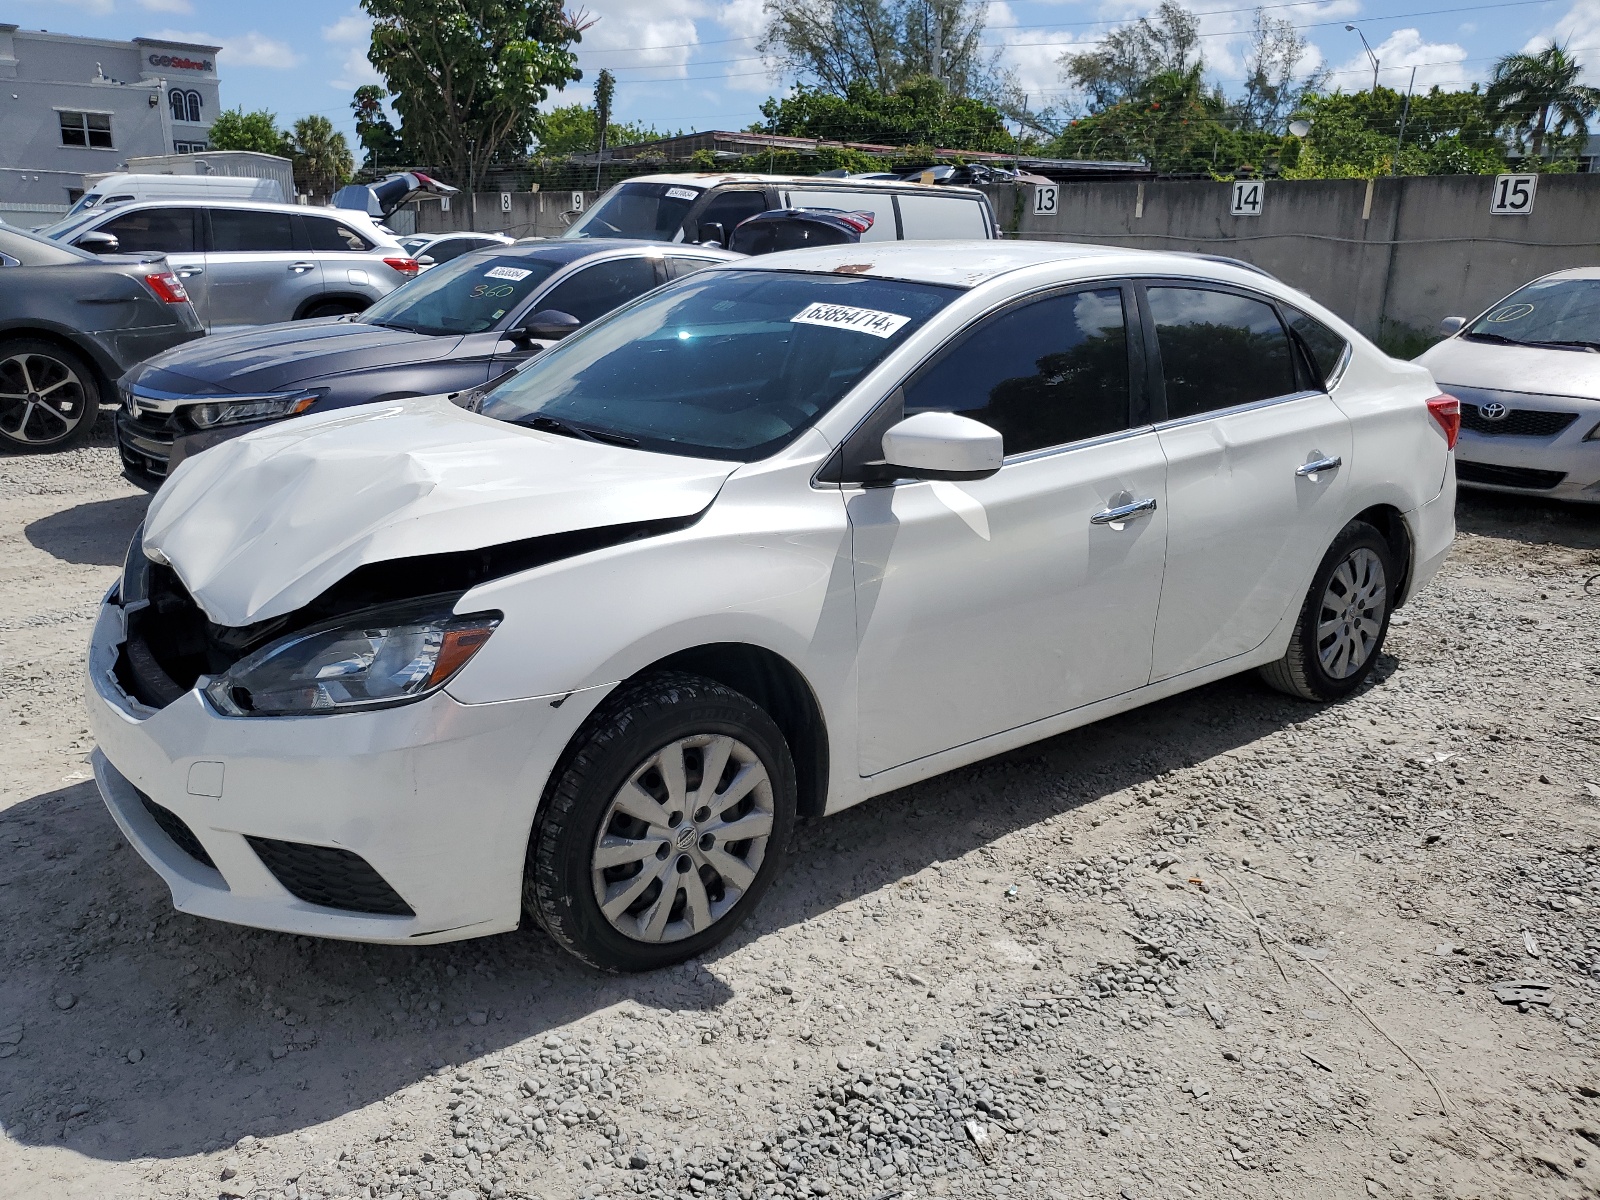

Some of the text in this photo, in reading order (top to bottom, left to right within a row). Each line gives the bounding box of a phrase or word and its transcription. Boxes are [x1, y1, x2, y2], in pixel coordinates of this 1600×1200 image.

[503, 195, 509, 209] 8
[575, 194, 581, 209] 9
[1037, 188, 1055, 211] 13
[1235, 185, 1259, 210] 14
[1497, 178, 1530, 209] 15
[470, 284, 514, 298] 360
